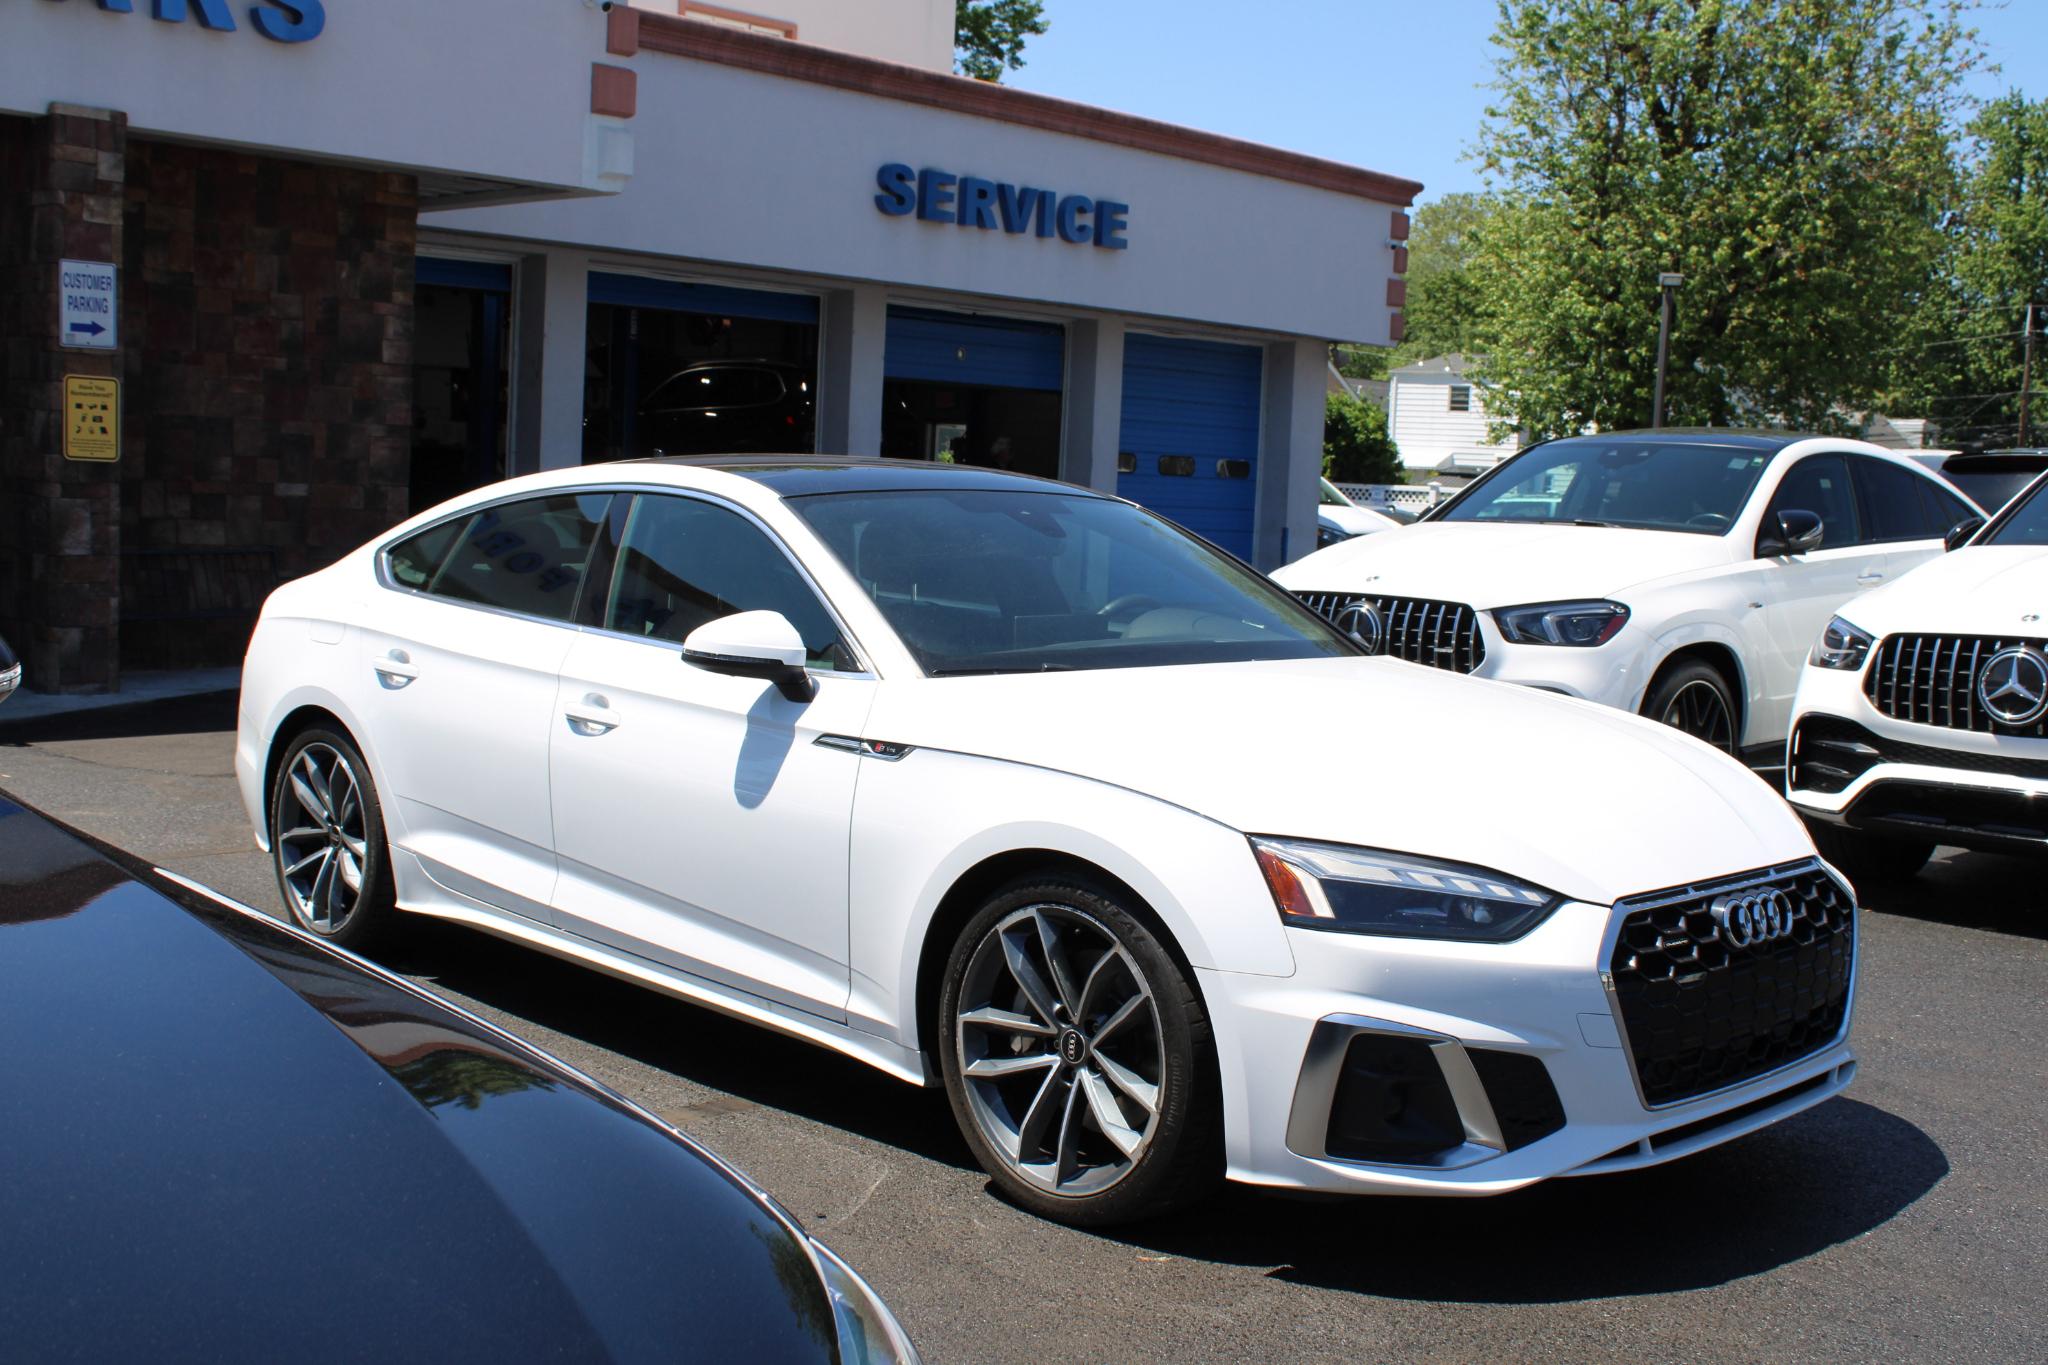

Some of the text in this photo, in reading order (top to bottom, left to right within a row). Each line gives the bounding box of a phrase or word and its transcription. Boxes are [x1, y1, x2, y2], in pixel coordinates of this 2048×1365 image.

[874, 162, 1129, 250] SERVICE
[64, 272, 112, 291] CUSTOMER
[67, 295, 109, 314] PARKING
